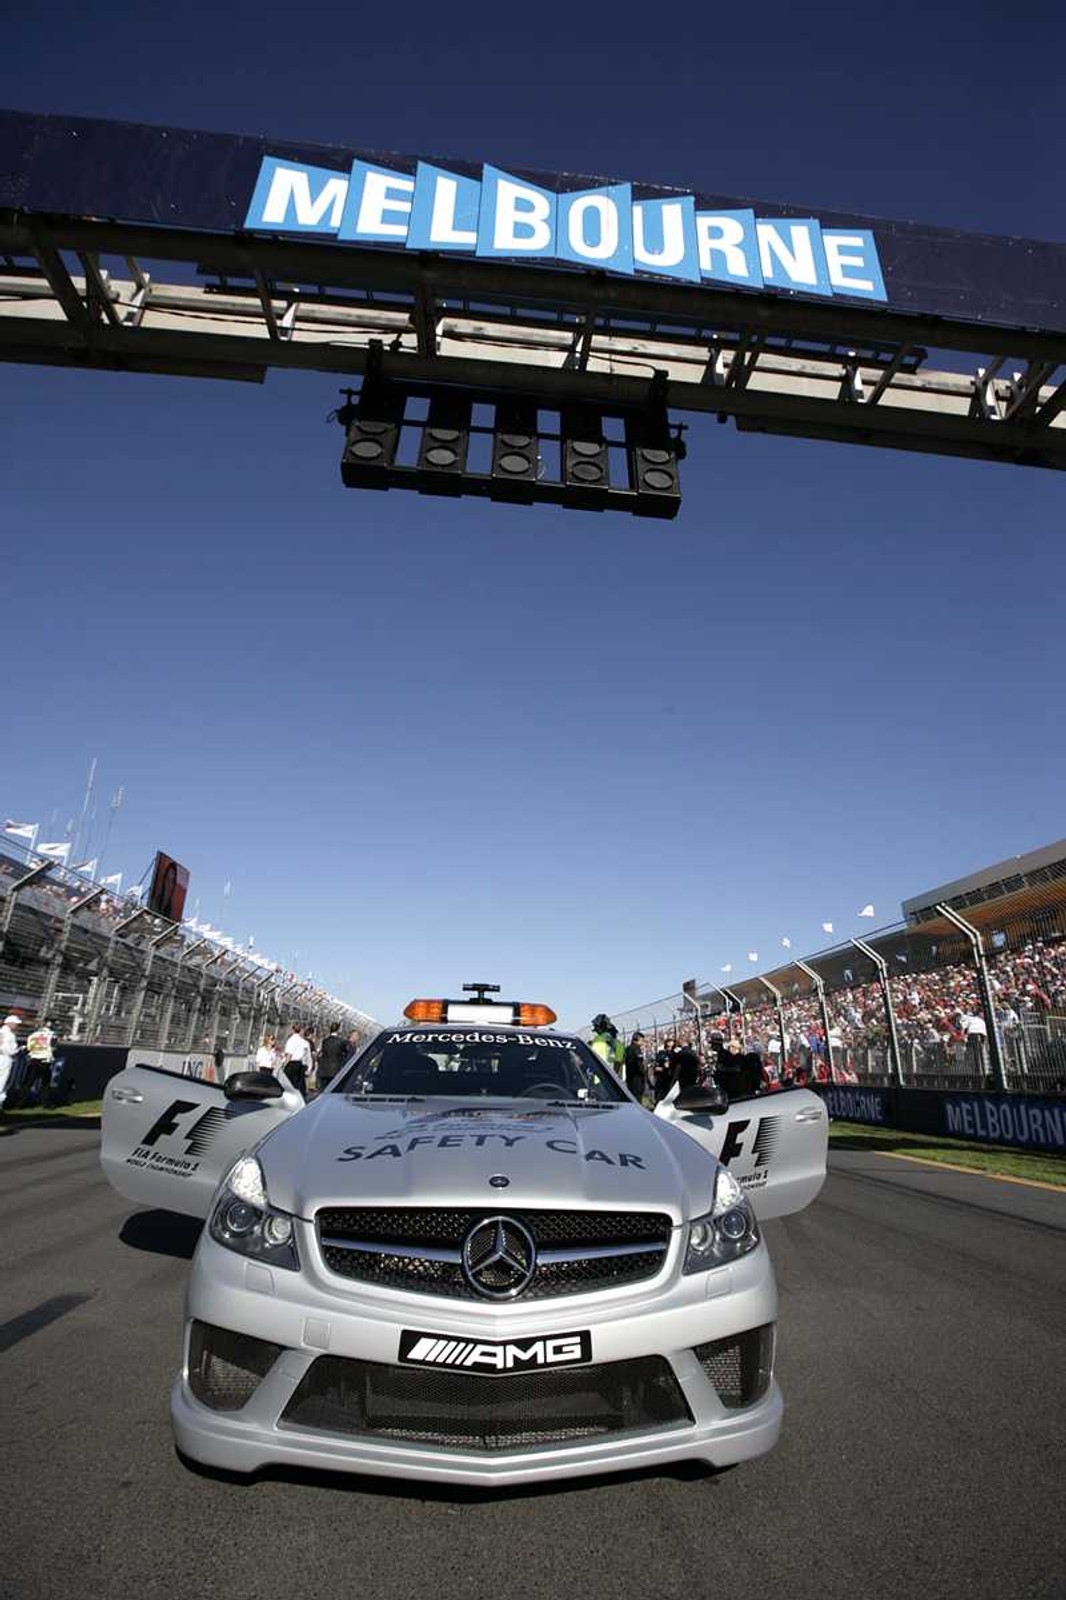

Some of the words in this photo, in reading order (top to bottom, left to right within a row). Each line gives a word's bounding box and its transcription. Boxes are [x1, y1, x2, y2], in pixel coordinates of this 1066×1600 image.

[260, 166, 875, 291] MELBOURNE
[385, 1031, 577, 1050] Mercedes-Benz
[141, 1099, 235, 1158] F1
[719, 1115, 780, 1167] F1
[945, 1098, 1066, 1145] MELBOURN
[131, 1146, 151, 1159] FIA
[149, 1151, 191, 1170] Formula
[336, 1133, 525, 1163] SAFETY
[545, 1139, 647, 1170] CAR
[462, 1335, 582, 1370] AMG
